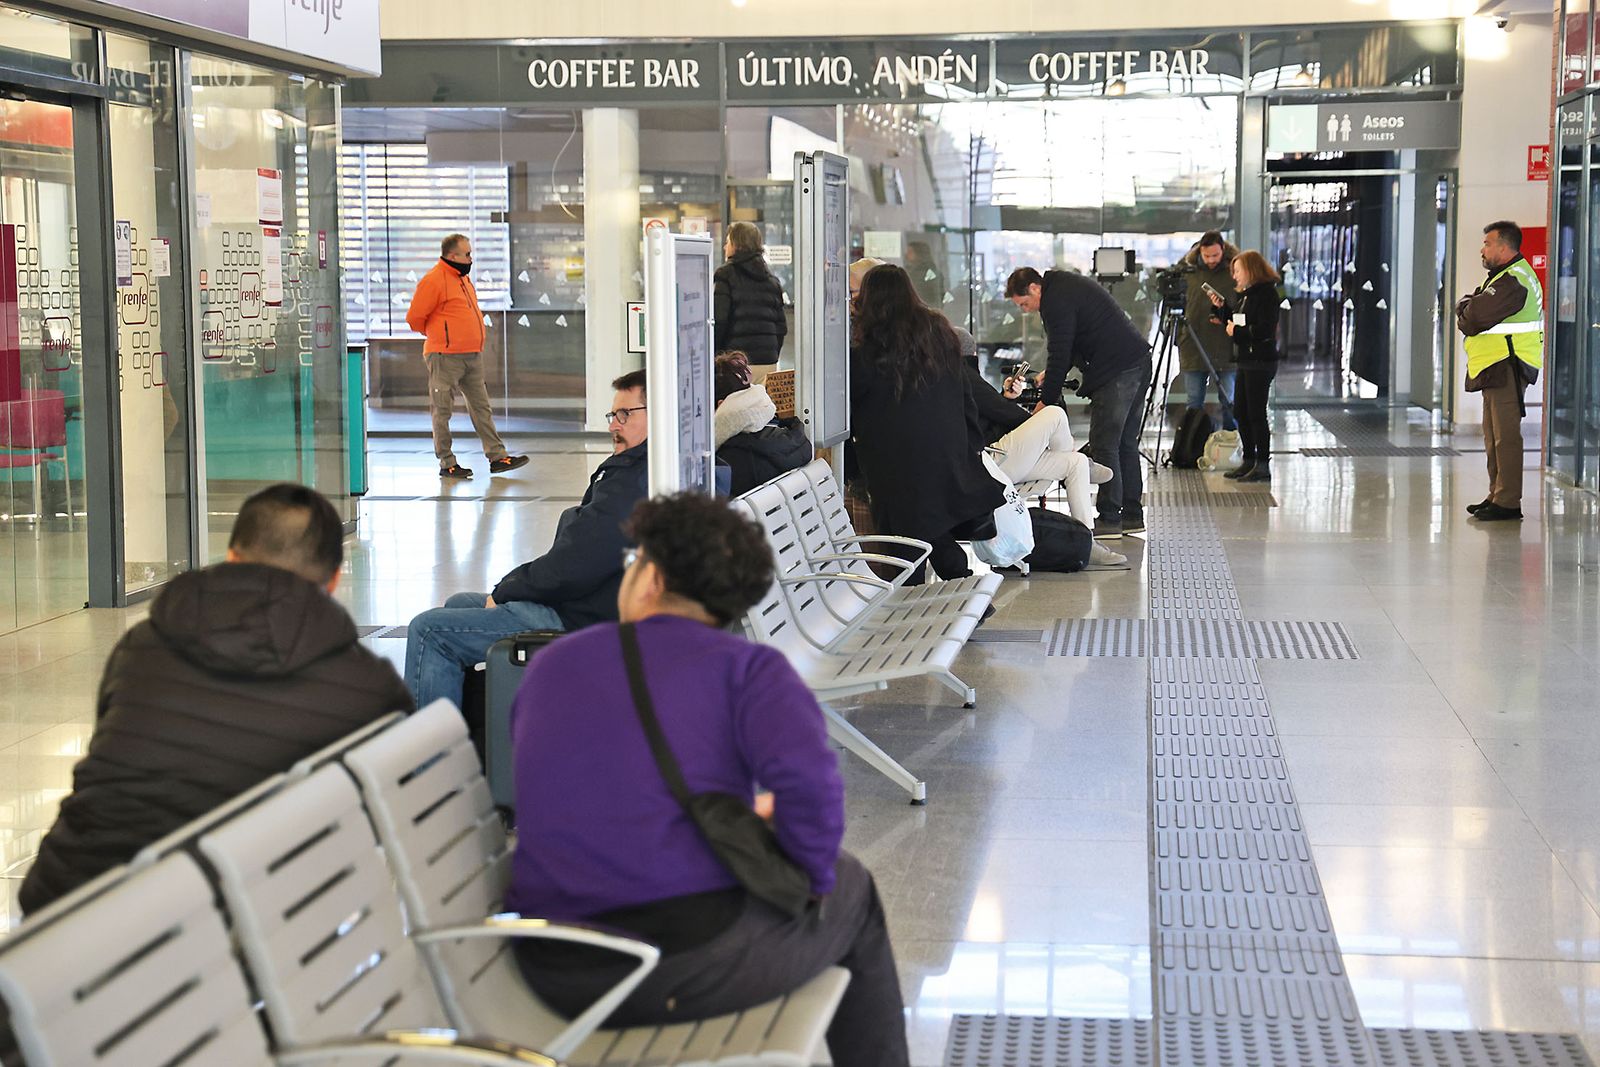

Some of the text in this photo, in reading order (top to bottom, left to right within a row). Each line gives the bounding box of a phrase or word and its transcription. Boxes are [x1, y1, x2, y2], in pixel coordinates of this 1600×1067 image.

[291, 0, 343, 35] nfe
[527, 59, 700, 88] COFFEE BAR
[738, 49, 977, 86] ÚLTIMO ANDÉN
[1028, 49, 1210, 82] COFFEE BAR
[1362, 114, 1404, 128] Aseos
[1362, 132, 1395, 141] TOILETS
[123, 286, 147, 311] renfe
[241, 284, 260, 307] renfe
[44, 331, 71, 357] renfe
[203, 323, 224, 346] renfe
